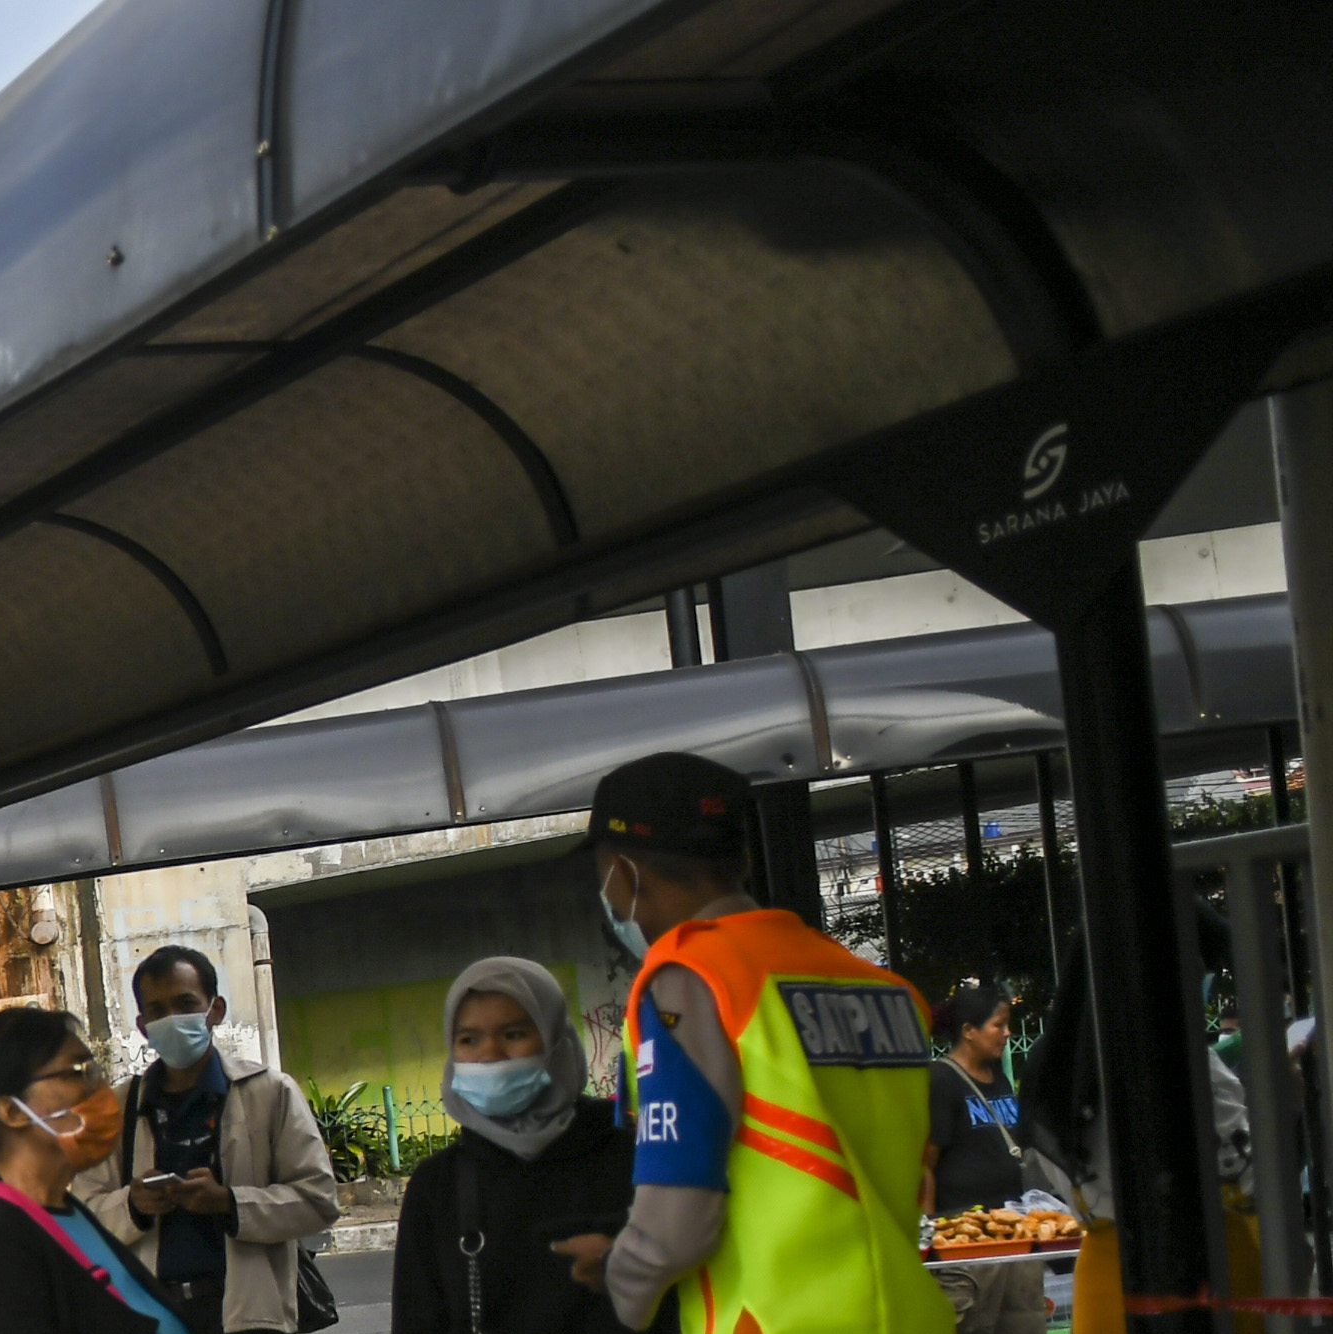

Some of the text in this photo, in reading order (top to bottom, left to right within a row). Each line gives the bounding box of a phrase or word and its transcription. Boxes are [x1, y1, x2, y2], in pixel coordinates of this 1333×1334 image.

[978, 480, 1131, 544] SARANA JAYA
[791, 991, 924, 1055] SATPAM
[635, 1102, 679, 1146] NER
